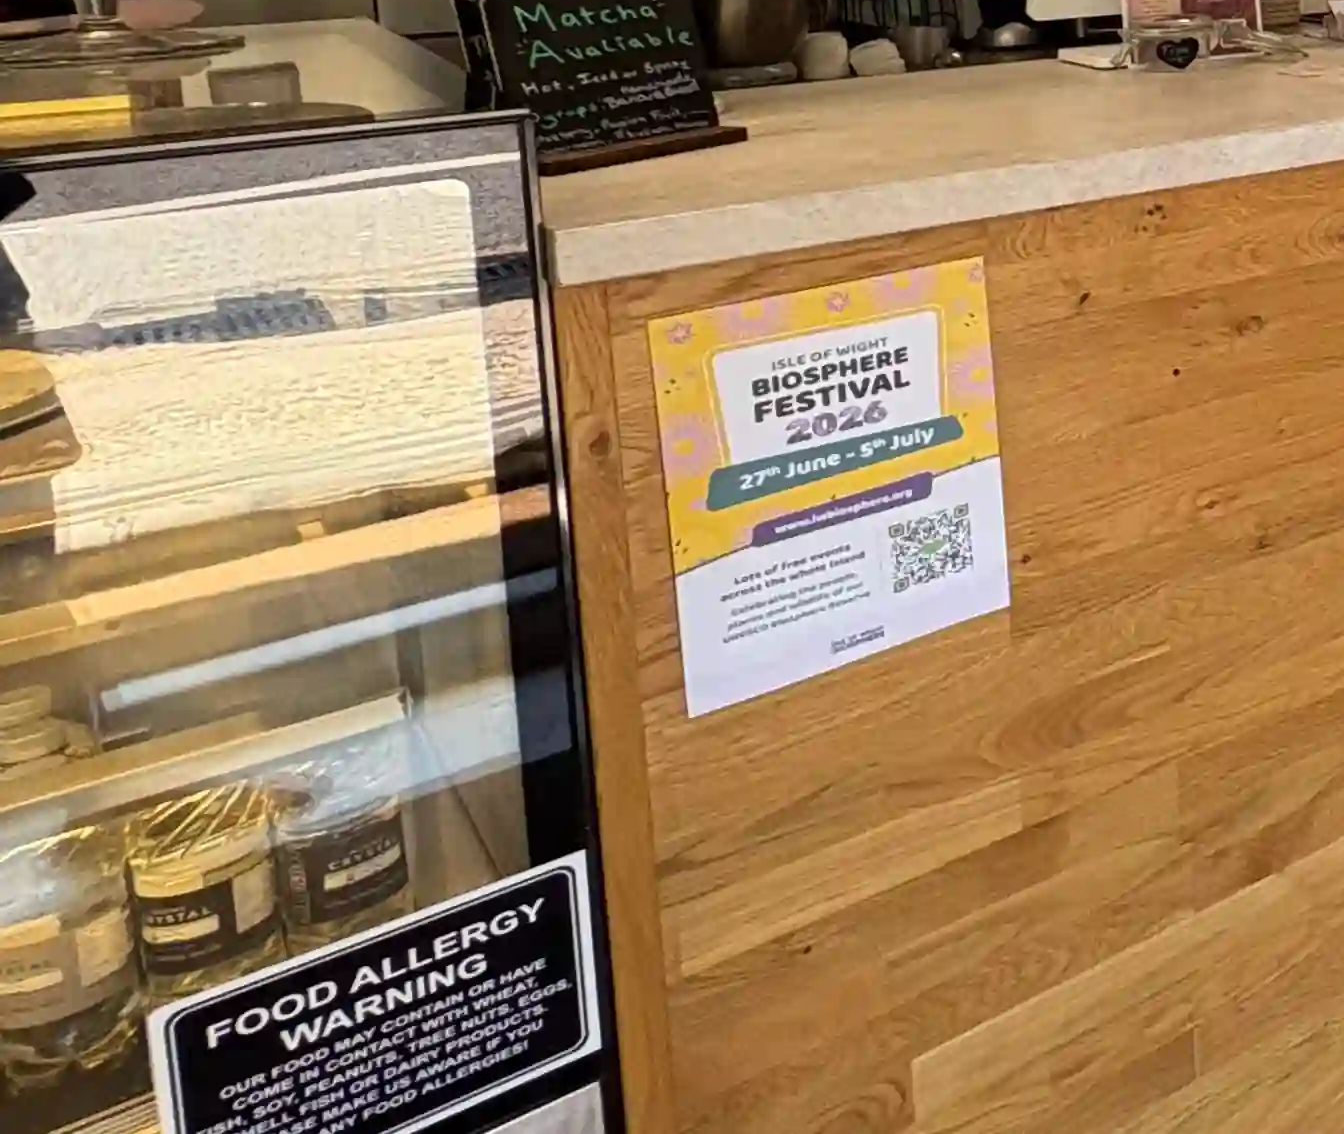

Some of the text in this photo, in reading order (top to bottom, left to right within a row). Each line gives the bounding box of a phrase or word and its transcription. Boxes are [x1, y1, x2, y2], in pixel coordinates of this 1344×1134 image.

[513, 1, 658, 34] Matcha
[750, 346, 910, 397] BIOSPHERE
[771, 336, 889, 371] ISLE OF WIGHT
[753, 368, 911, 423] FESTIVAL
[785, 399, 888, 446] 2026
[739, 465, 782, 492] 27th
[784, 450, 842, 479] June
[859, 437, 887, 458] 5th
[889, 425, 935, 452] July
[720, 584, 762, 602] across
[765, 577, 787, 588] the
[789, 565, 827, 581] whole
[734, 544, 851, 585] Lots of free events
[832, 586, 844, 597] of
[206, 898, 547, 1050] FOOD ALLERGY
[219, 957, 547, 1100] OUR FOOD MAY CONTAIN OR HAVE
[280, 953, 489, 1051] WARNING
[232, 1076, 294, 1110] COME
[300, 1066, 320, 1083] IN
[325, 1026, 418, 1072] CONTACT
[421, 1005, 469, 1032] WITH
[407, 1025, 457, 1053] TREE
[299, 1088, 345, 1115] FISH
[349, 1074, 380, 1094] OR
[384, 1047, 441, 1080] DAIRY
[322, 1018, 544, 1122] MAKE US AWARE IF YOU
[362, 1089, 418, 1121] FOOD
[421, 1039, 529, 1095] ALLERGIES!
